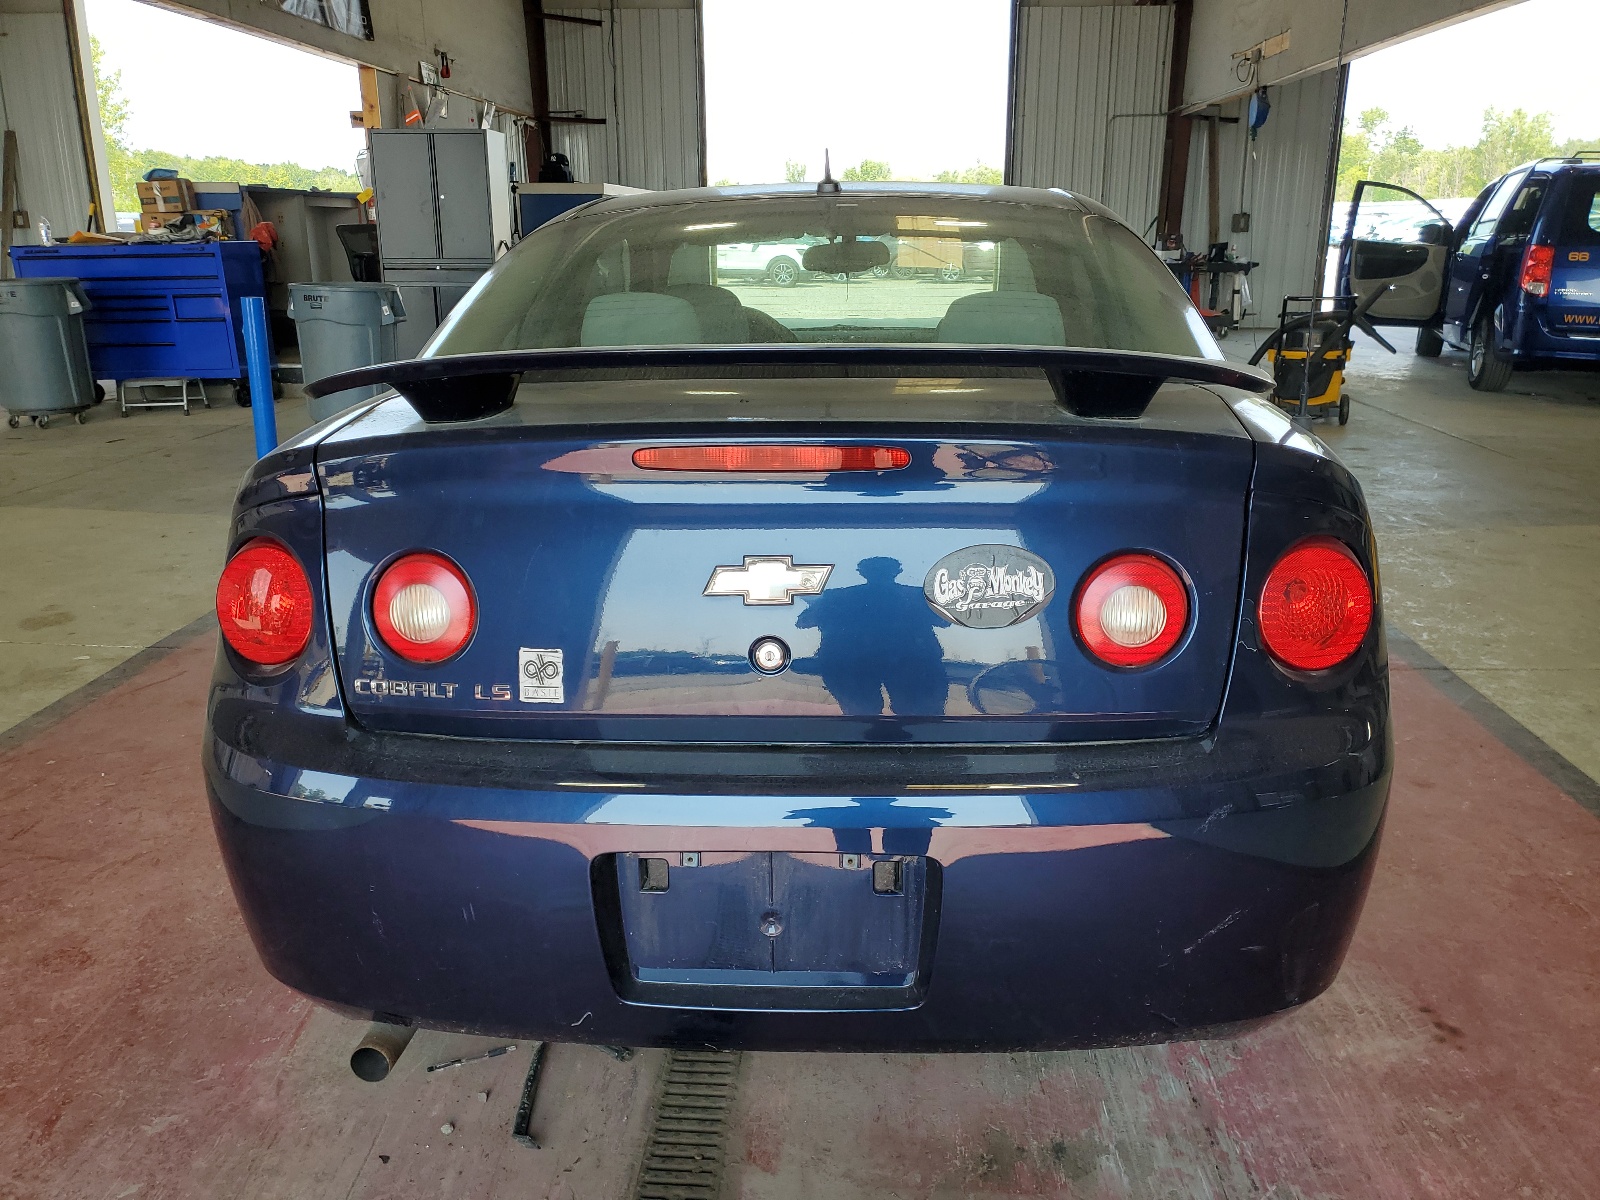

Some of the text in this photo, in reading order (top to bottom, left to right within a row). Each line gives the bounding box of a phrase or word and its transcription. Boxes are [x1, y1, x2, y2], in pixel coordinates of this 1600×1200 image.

[303, 294, 330, 303] BRUTE
[933, 563, 1045, 605] Gas Monkey
[956, 599, 1026, 612] Garage
[354, 678, 512, 701] COBALT LS
